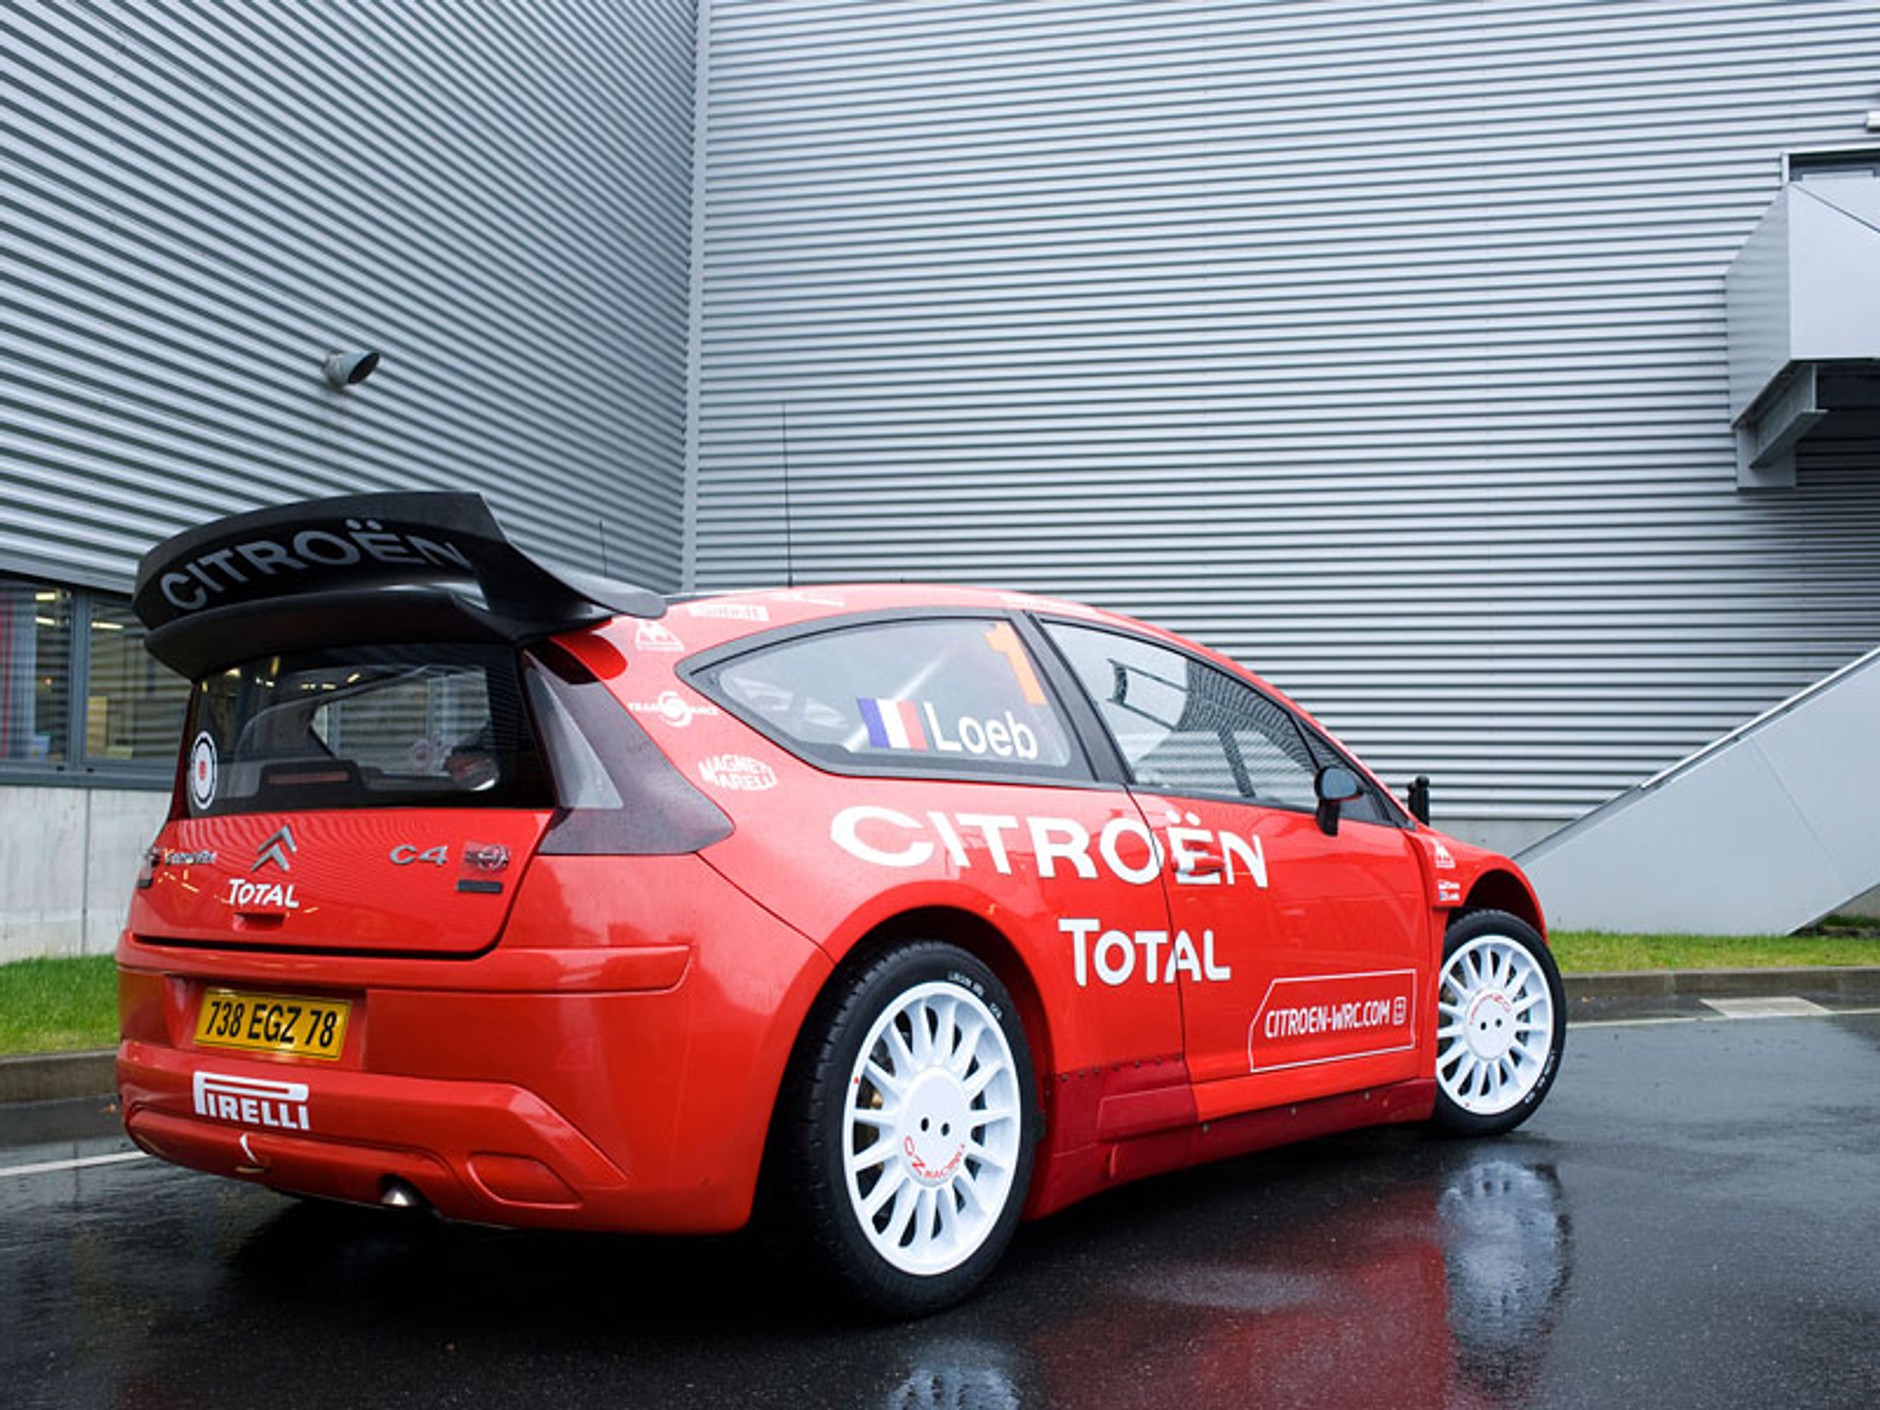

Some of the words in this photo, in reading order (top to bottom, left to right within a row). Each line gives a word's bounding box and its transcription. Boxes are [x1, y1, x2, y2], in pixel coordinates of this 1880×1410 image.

[160, 520, 470, 610] CITROËN
[925, 703, 1037, 759] Loeb
[390, 845, 448, 866] C4
[832, 806, 1268, 888] CITROËN
[228, 878, 300, 908] TOTAL
[1058, 918, 1231, 987] TOTAL
[205, 1000, 243, 1038] 738
[247, 1005, 302, 1043] EGZ
[305, 1011, 338, 1049] 78
[1265, 1000, 1390, 1038] CITROEN-WRC.COM
[193, 1072, 309, 1131] PIRELLI
